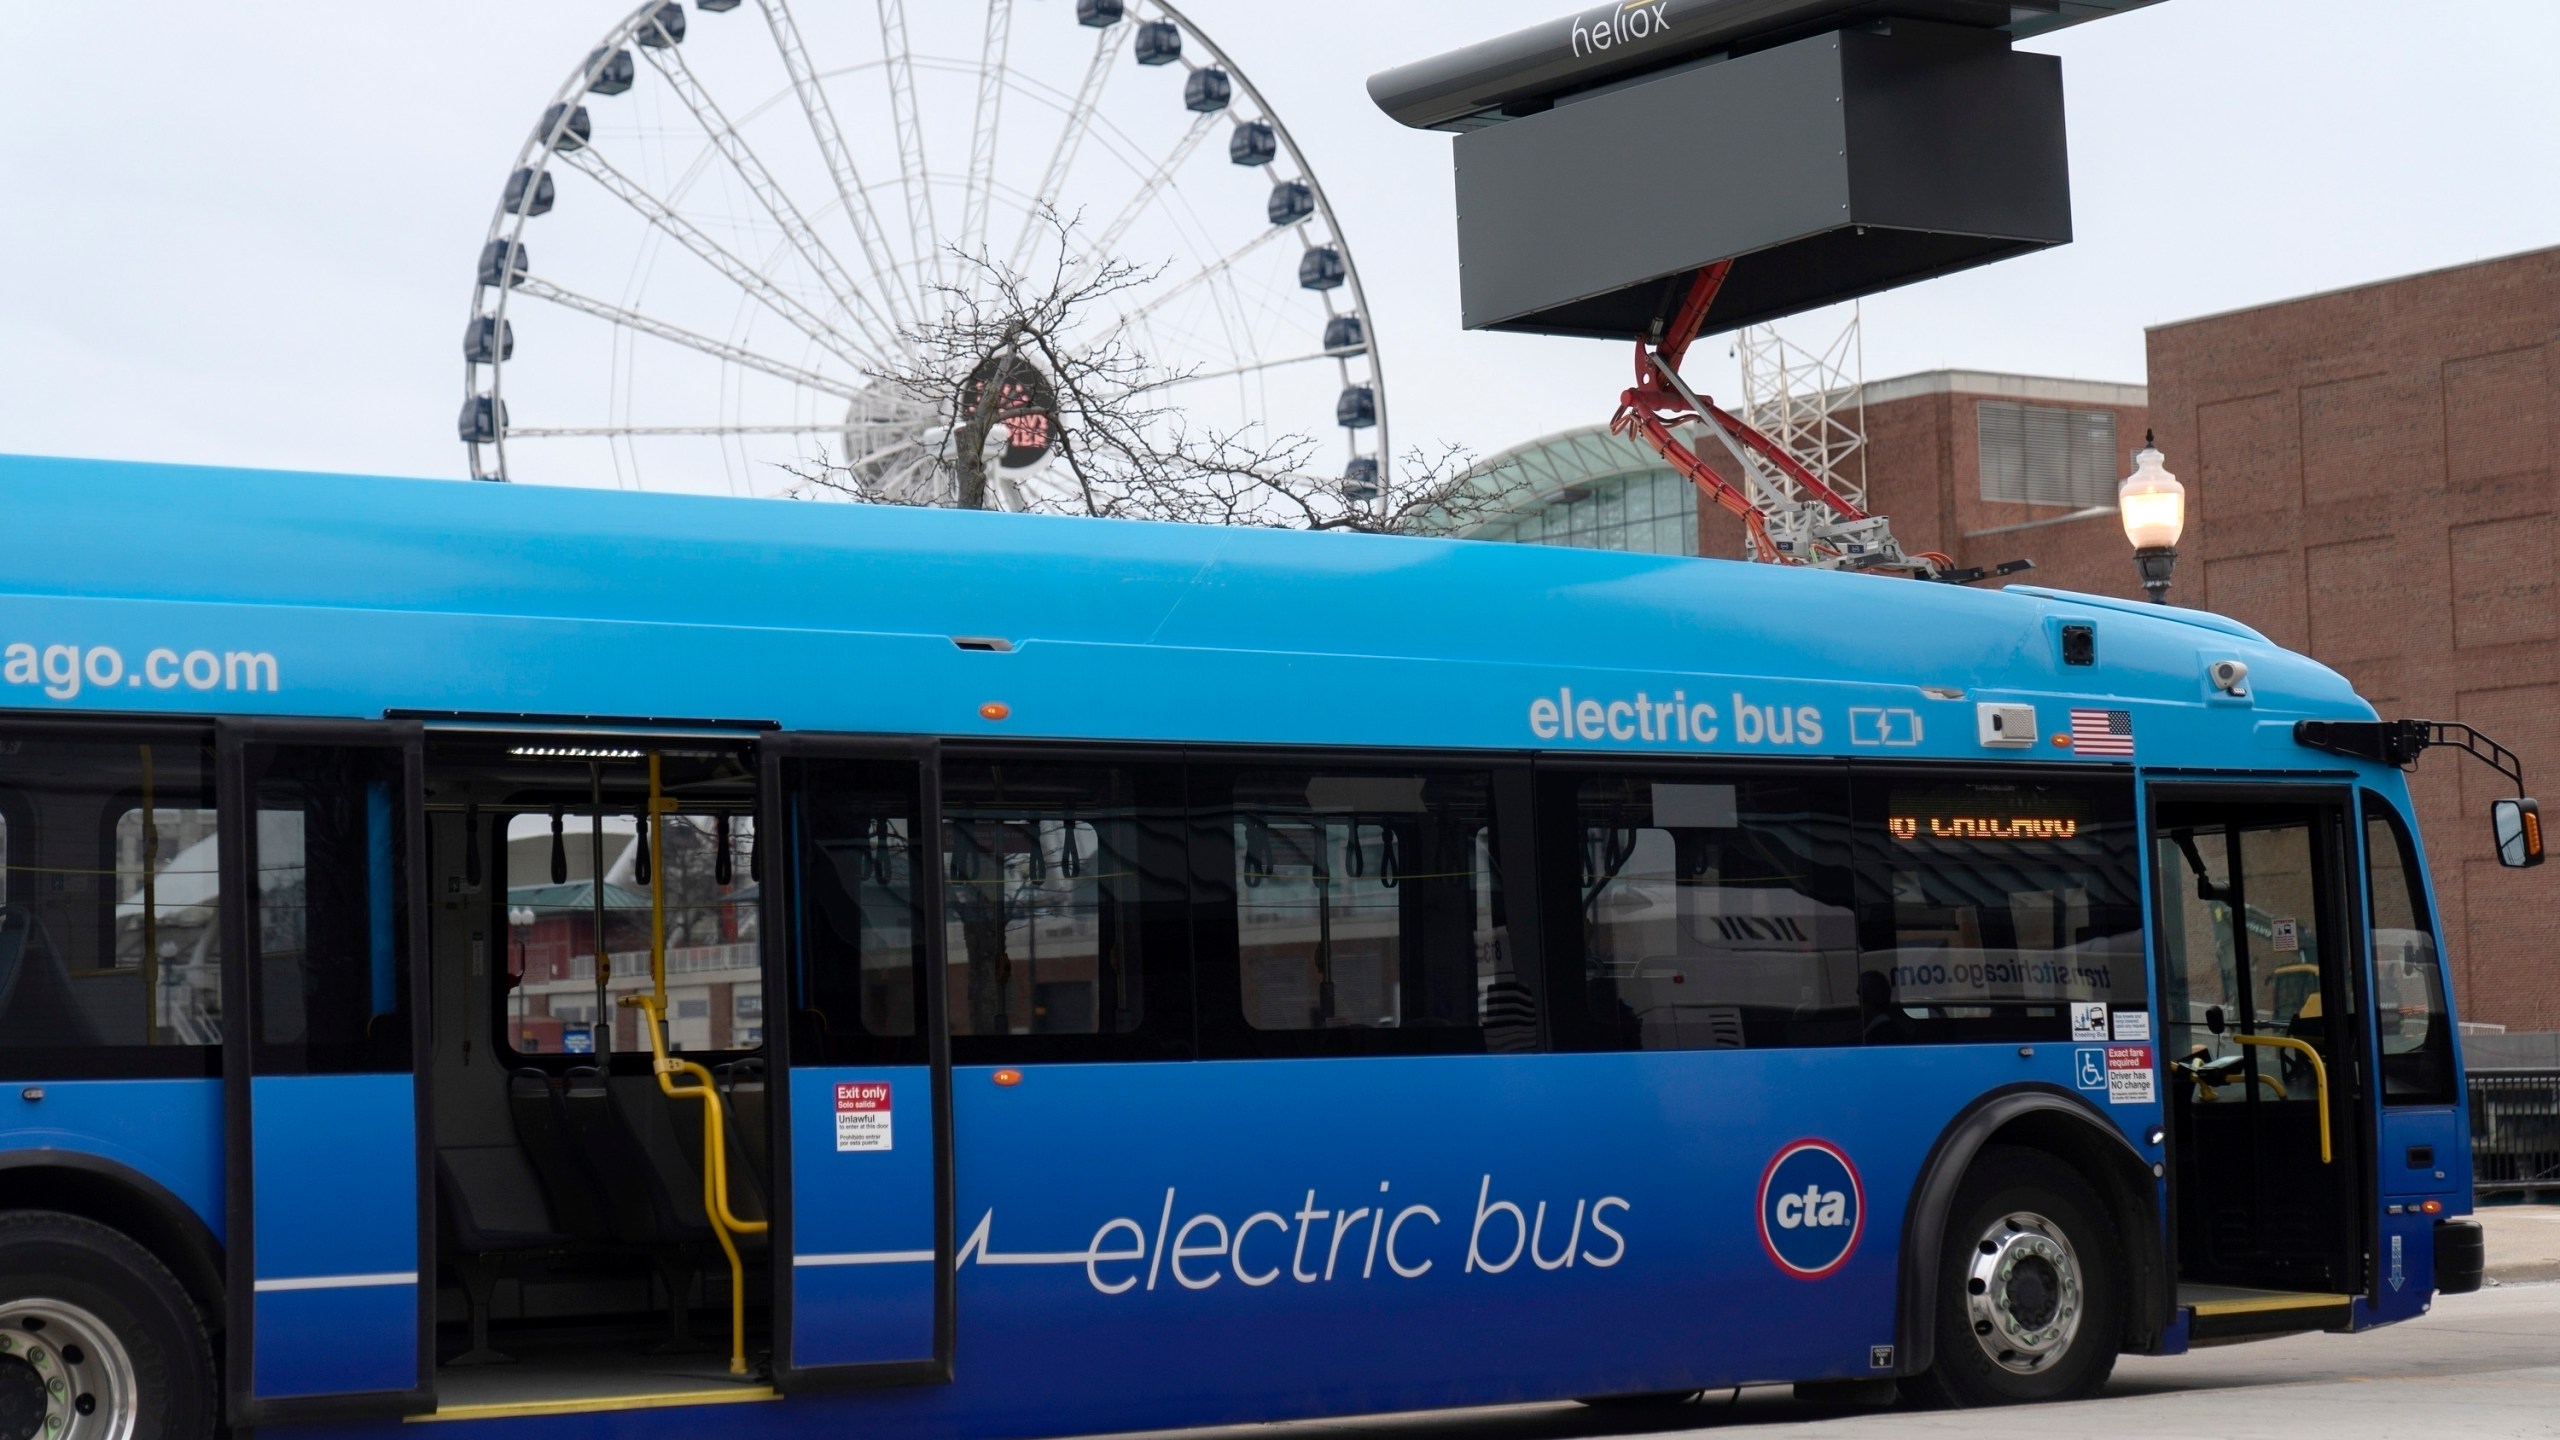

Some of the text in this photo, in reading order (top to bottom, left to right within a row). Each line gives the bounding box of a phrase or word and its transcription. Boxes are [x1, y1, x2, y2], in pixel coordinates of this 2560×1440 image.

[1572, 1, 1670, 57] heliox
[4, 642, 278, 700] ago.com
[1529, 687, 1823, 745] electric bus
[2074, 1031, 2096, 1039] Kneeling
[2108, 1048, 2144, 1058] Exact fare
[2109, 1058, 2139, 1068] required
[2110, 1071, 2146, 1080] Driver has
[2111, 1081, 2151, 1090] NO change
[838, 1086, 887, 1101] Exit only
[838, 1100, 876, 1109] Solo salida
[838, 1115, 875, 1123] Unlawful
[1776, 1184, 1846, 1229] cta
[1086, 1173, 1631, 1295] electric bus
